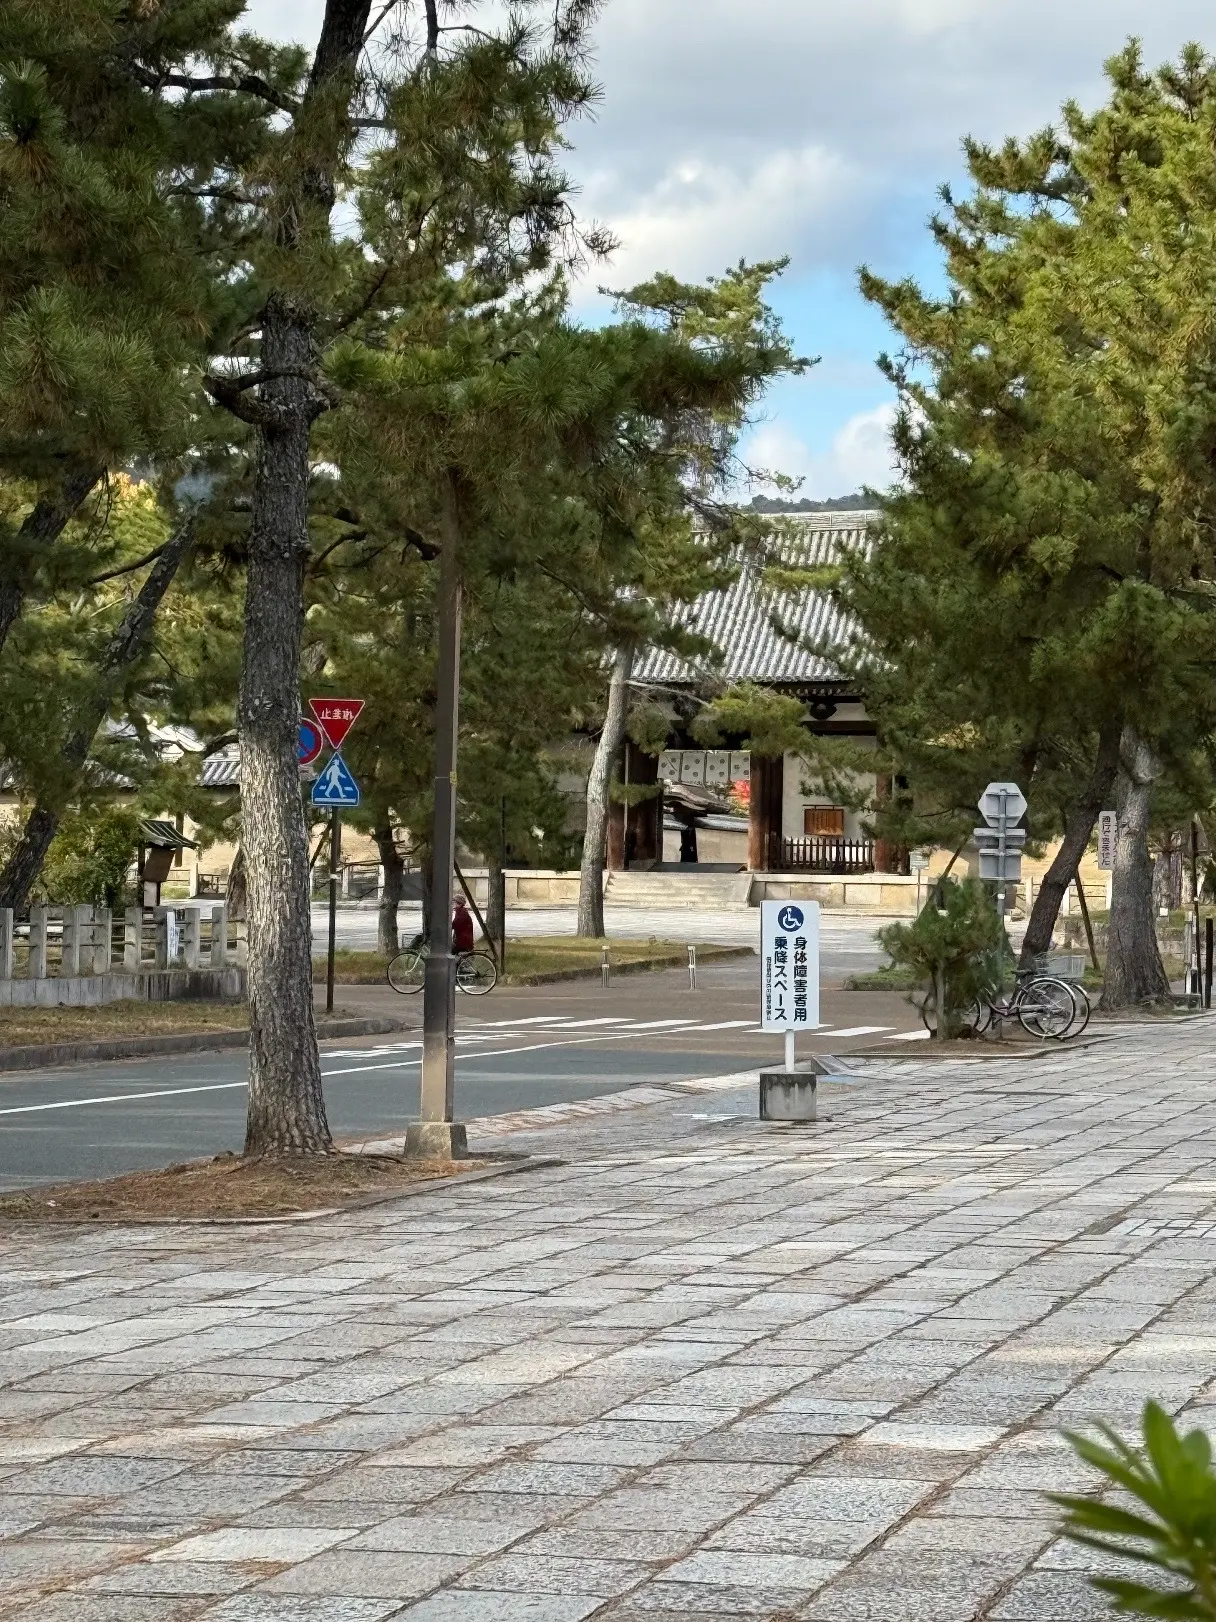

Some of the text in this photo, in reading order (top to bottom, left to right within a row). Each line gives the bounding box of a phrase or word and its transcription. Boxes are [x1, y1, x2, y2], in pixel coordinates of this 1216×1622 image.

[320, 707, 354, 720] 止まれ
[774, 936, 789, 1021] 乗降スペース
[793, 936, 808, 1022] 身体障害者用
